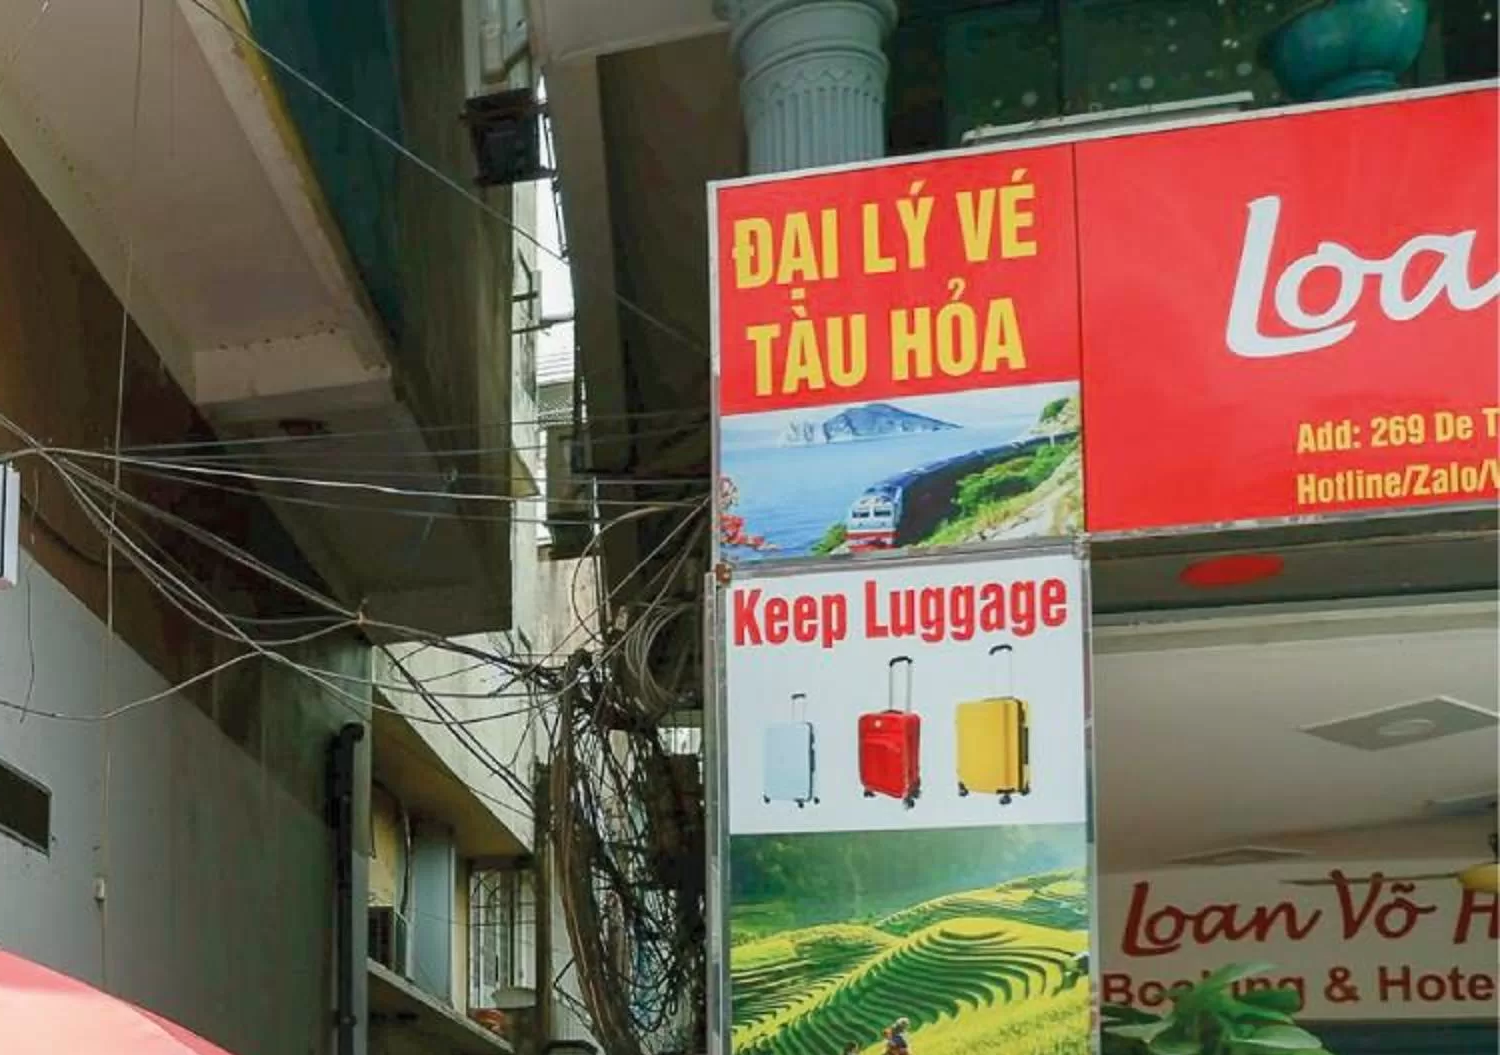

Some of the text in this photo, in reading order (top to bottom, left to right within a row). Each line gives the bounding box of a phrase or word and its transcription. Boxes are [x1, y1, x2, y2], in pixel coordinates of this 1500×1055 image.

[731, 168, 1038, 300] ĐẠI LÝ VÉ
[745, 277, 1027, 397] TÀU HỎA
[1297, 419, 1361, 455] Add:
[1370, 413, 1425, 447] 269
[1434, 411, 1474, 443] De
[733, 577, 1068, 649] Keep Luggage
[1122, 881, 1322, 957] Loan
[1329, 870, 1437, 940] Võ
[1324, 966, 1359, 1002] &
[1378, 965, 1495, 1002] Hote
